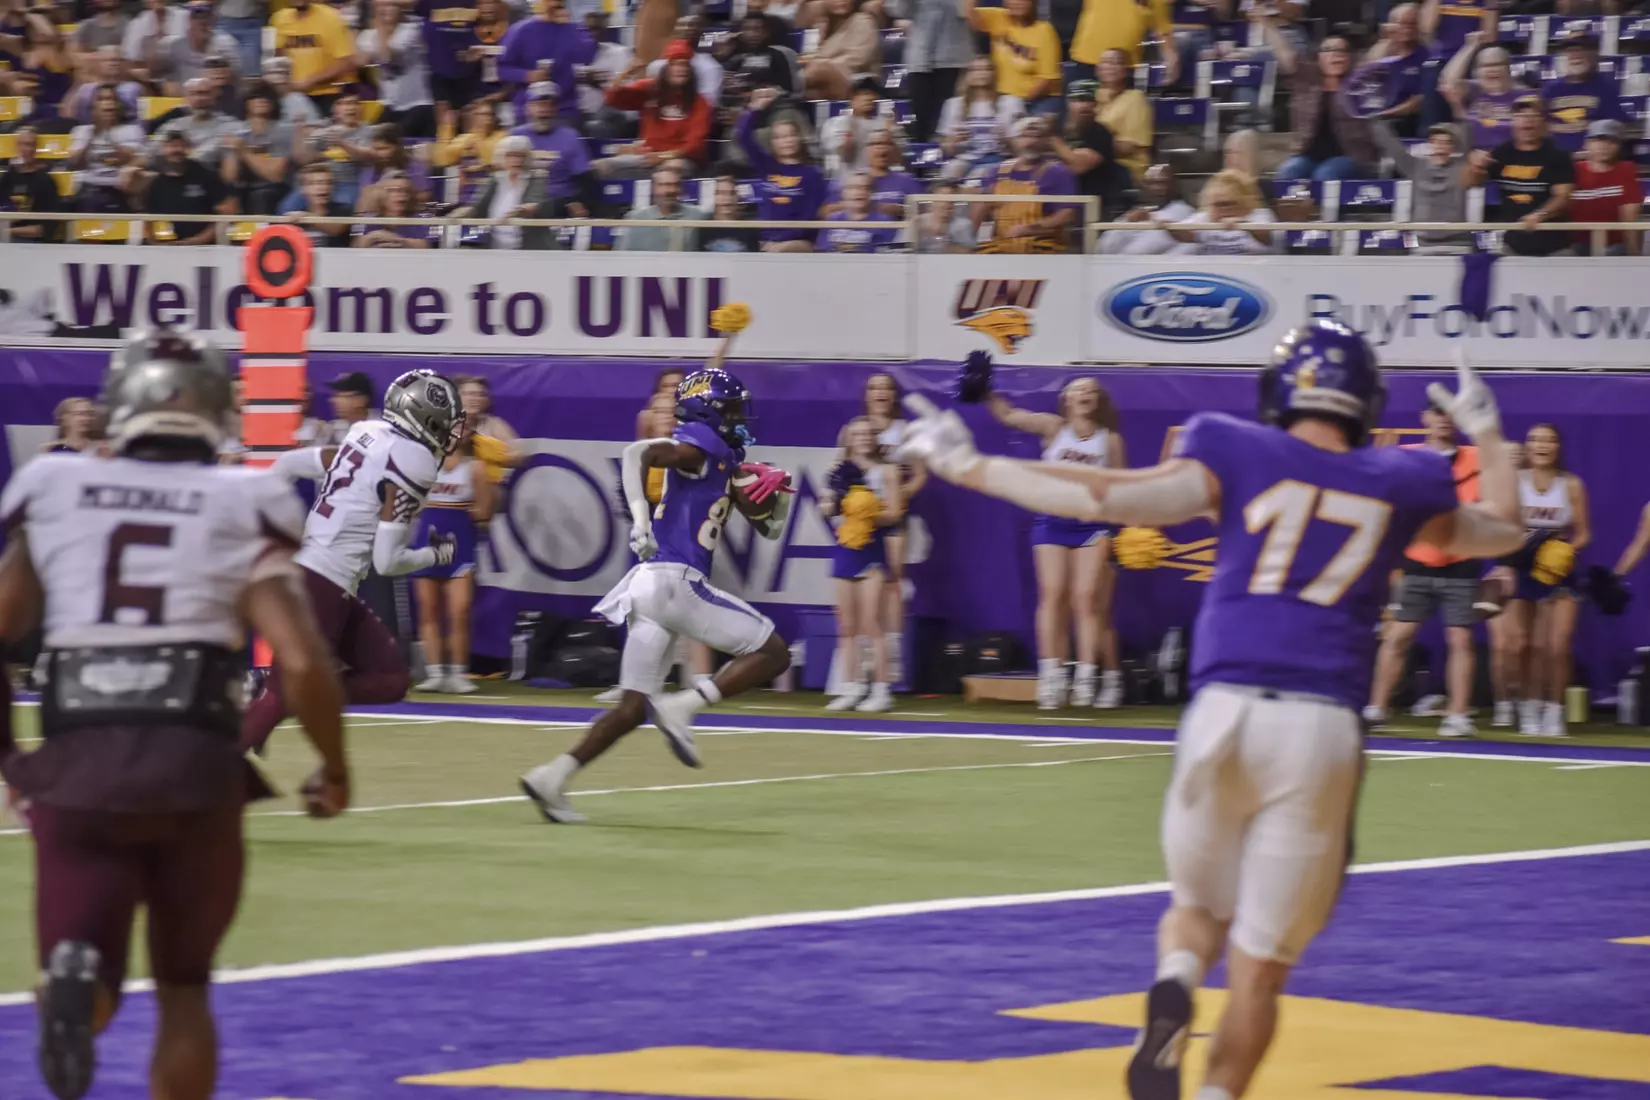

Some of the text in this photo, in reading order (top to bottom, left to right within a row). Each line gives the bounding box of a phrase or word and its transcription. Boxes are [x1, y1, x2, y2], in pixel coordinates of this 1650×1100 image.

[64, 263, 727, 338] Welcme to UNI
[954, 279, 1044, 319] UNI
[1129, 283, 1241, 329] Ford
[680, 373, 714, 396] UNI
[1243, 478, 1393, 606] 17
[97, 522, 175, 626] 6
